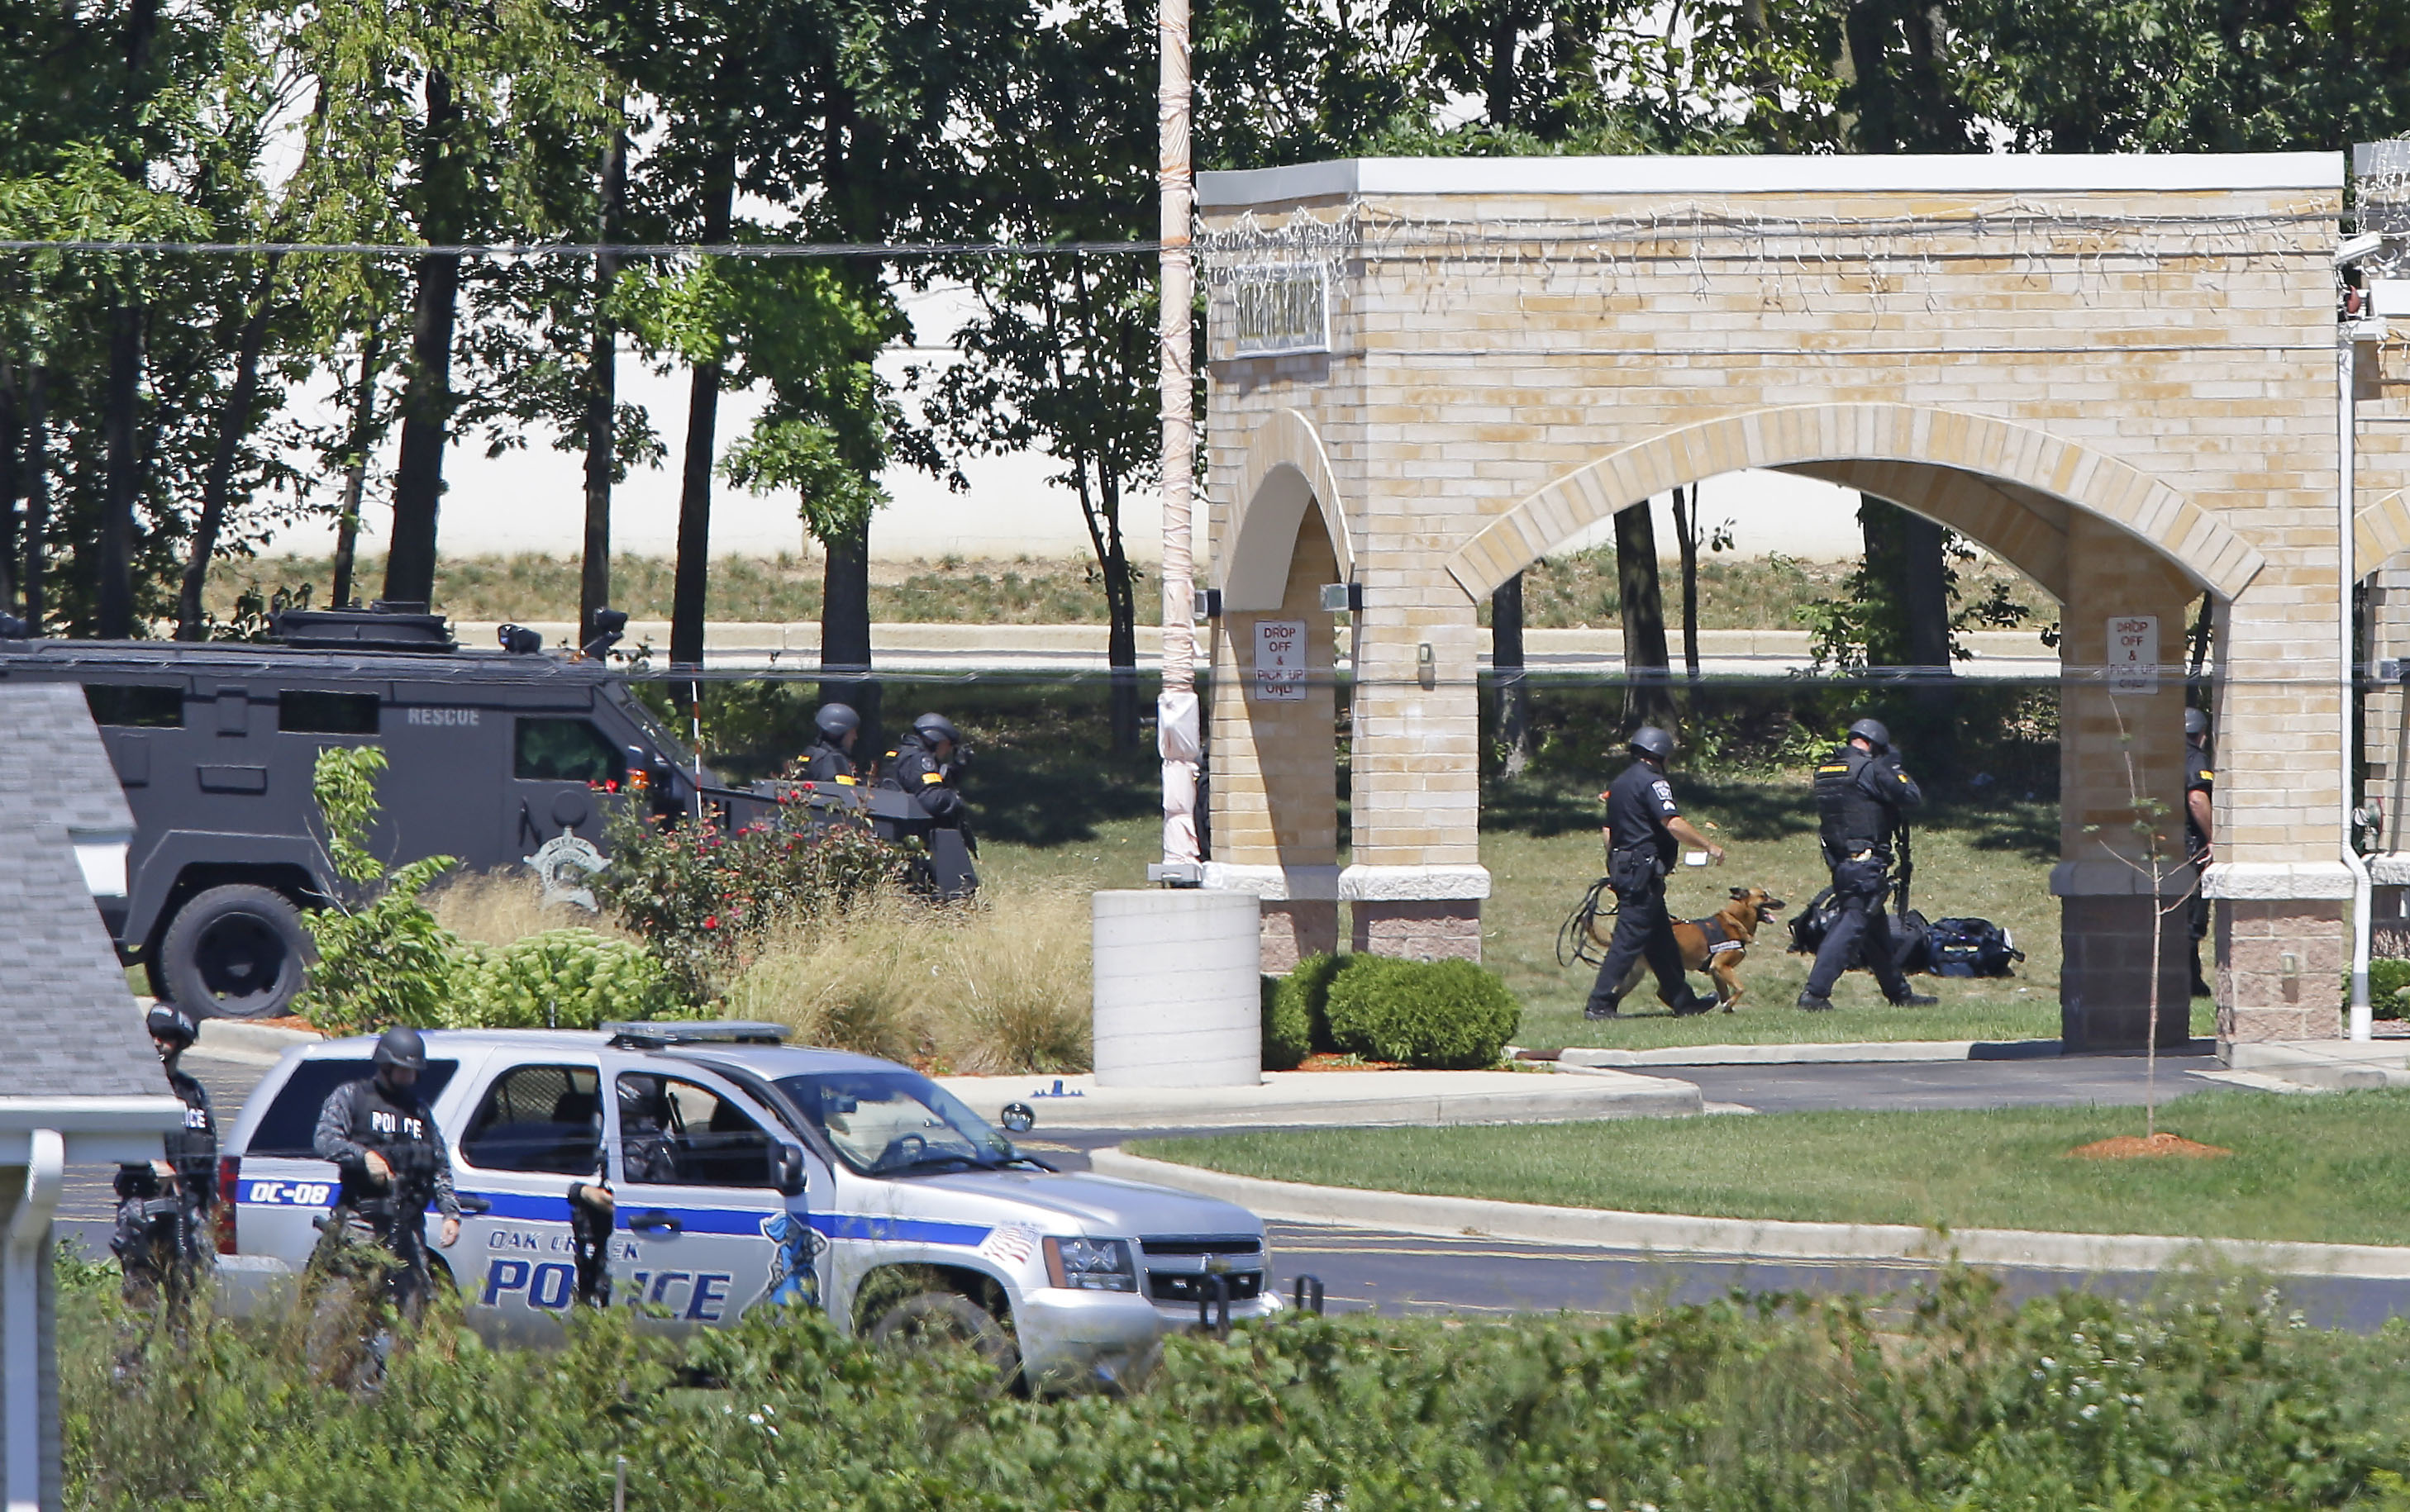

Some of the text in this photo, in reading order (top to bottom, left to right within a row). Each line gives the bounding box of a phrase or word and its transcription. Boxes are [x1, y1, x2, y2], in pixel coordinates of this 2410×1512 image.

[1264, 627, 1296, 639] DROP
[2117, 621, 2147, 633] DROP
[1269, 641, 1292, 652] OFF
[2121, 635, 2143, 646] OFF
[1276, 655, 1284, 665] &
[2129, 649, 2136, 661] &
[407, 707, 479, 726] RESCUE
[250, 1182, 330, 1205] OC-08
[488, 1230, 541, 1252] OAK
[478, 1257, 733, 1322] POICE
